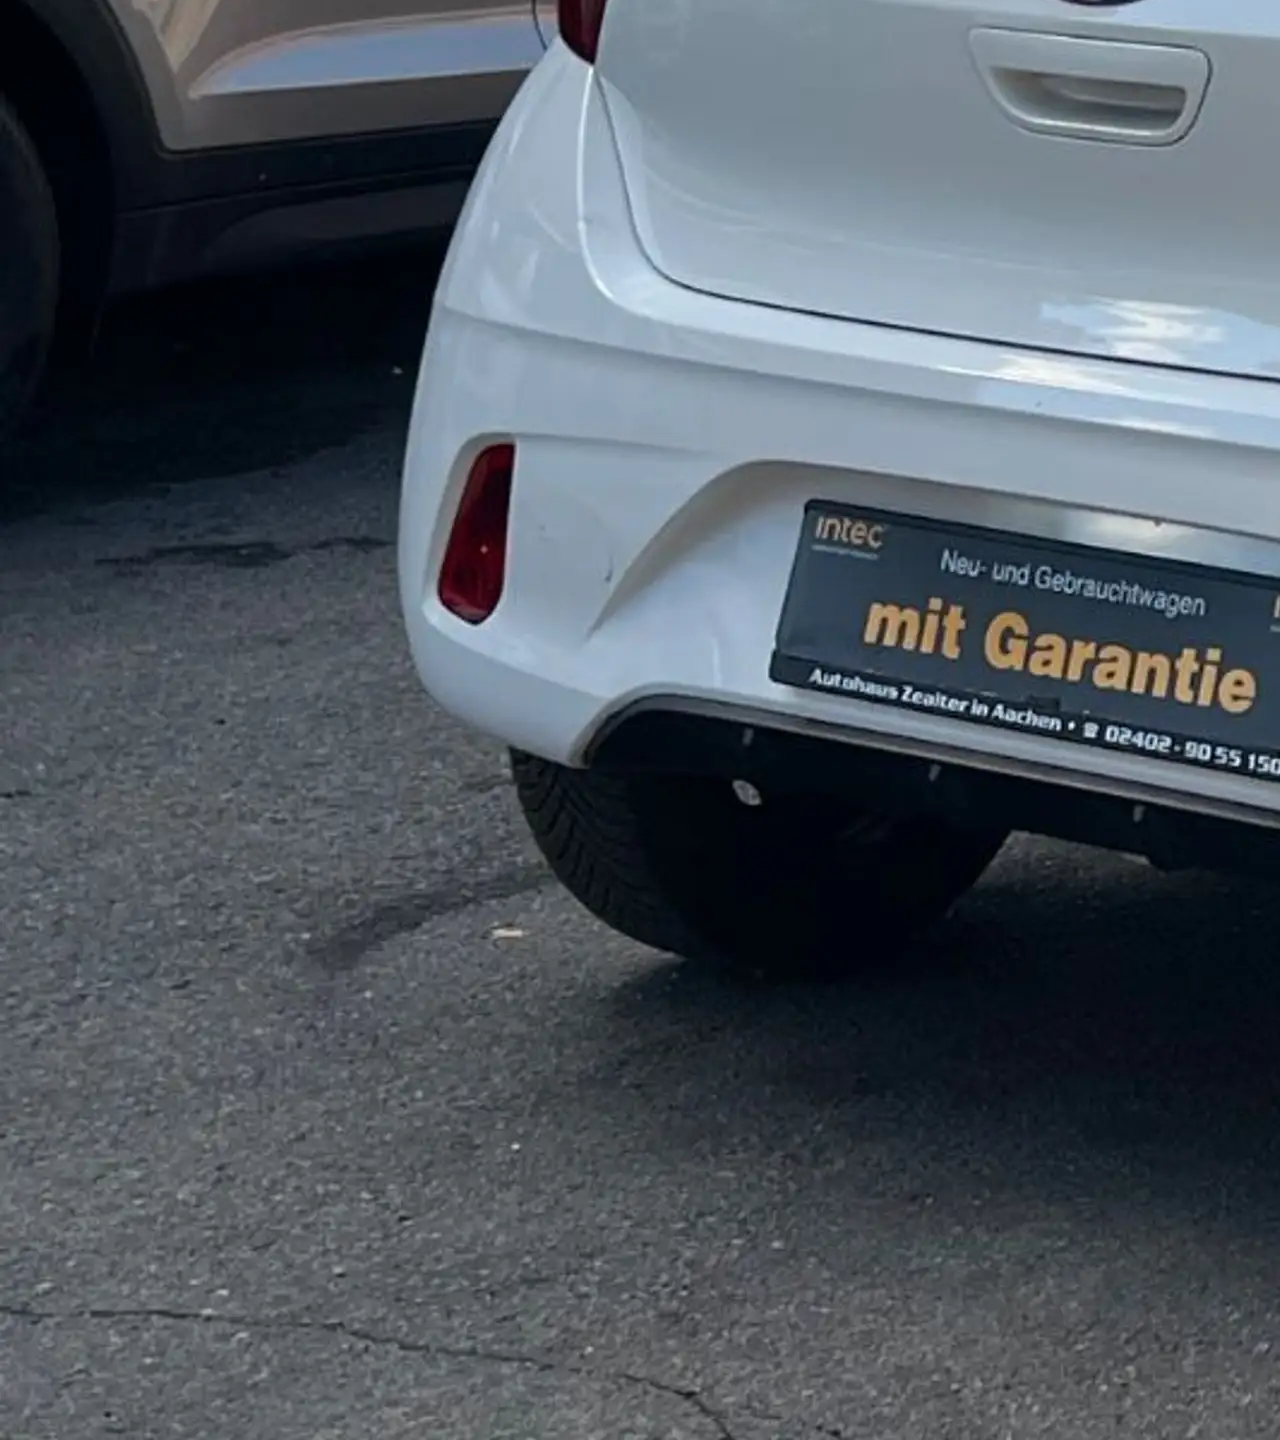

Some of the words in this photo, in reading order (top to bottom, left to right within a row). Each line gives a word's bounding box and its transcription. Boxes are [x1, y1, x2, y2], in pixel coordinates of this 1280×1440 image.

[815, 516, 884, 549] intec
[940, 548, 987, 578] Neu-
[992, 560, 1030, 586] und
[1034, 565, 1206, 619] Gebrauchtwagen
[863, 596, 967, 661] mit
[984, 611, 1257, 714] Garantie
[809, 667, 898, 700] Autohaus
[971, 698, 989, 717] in
[992, 704, 1062, 733] Aachen
[1104, 724, 1172, 754] 02402
[1184, 741, 1212, 762] 90
[1213, 746, 1243, 768] 55
